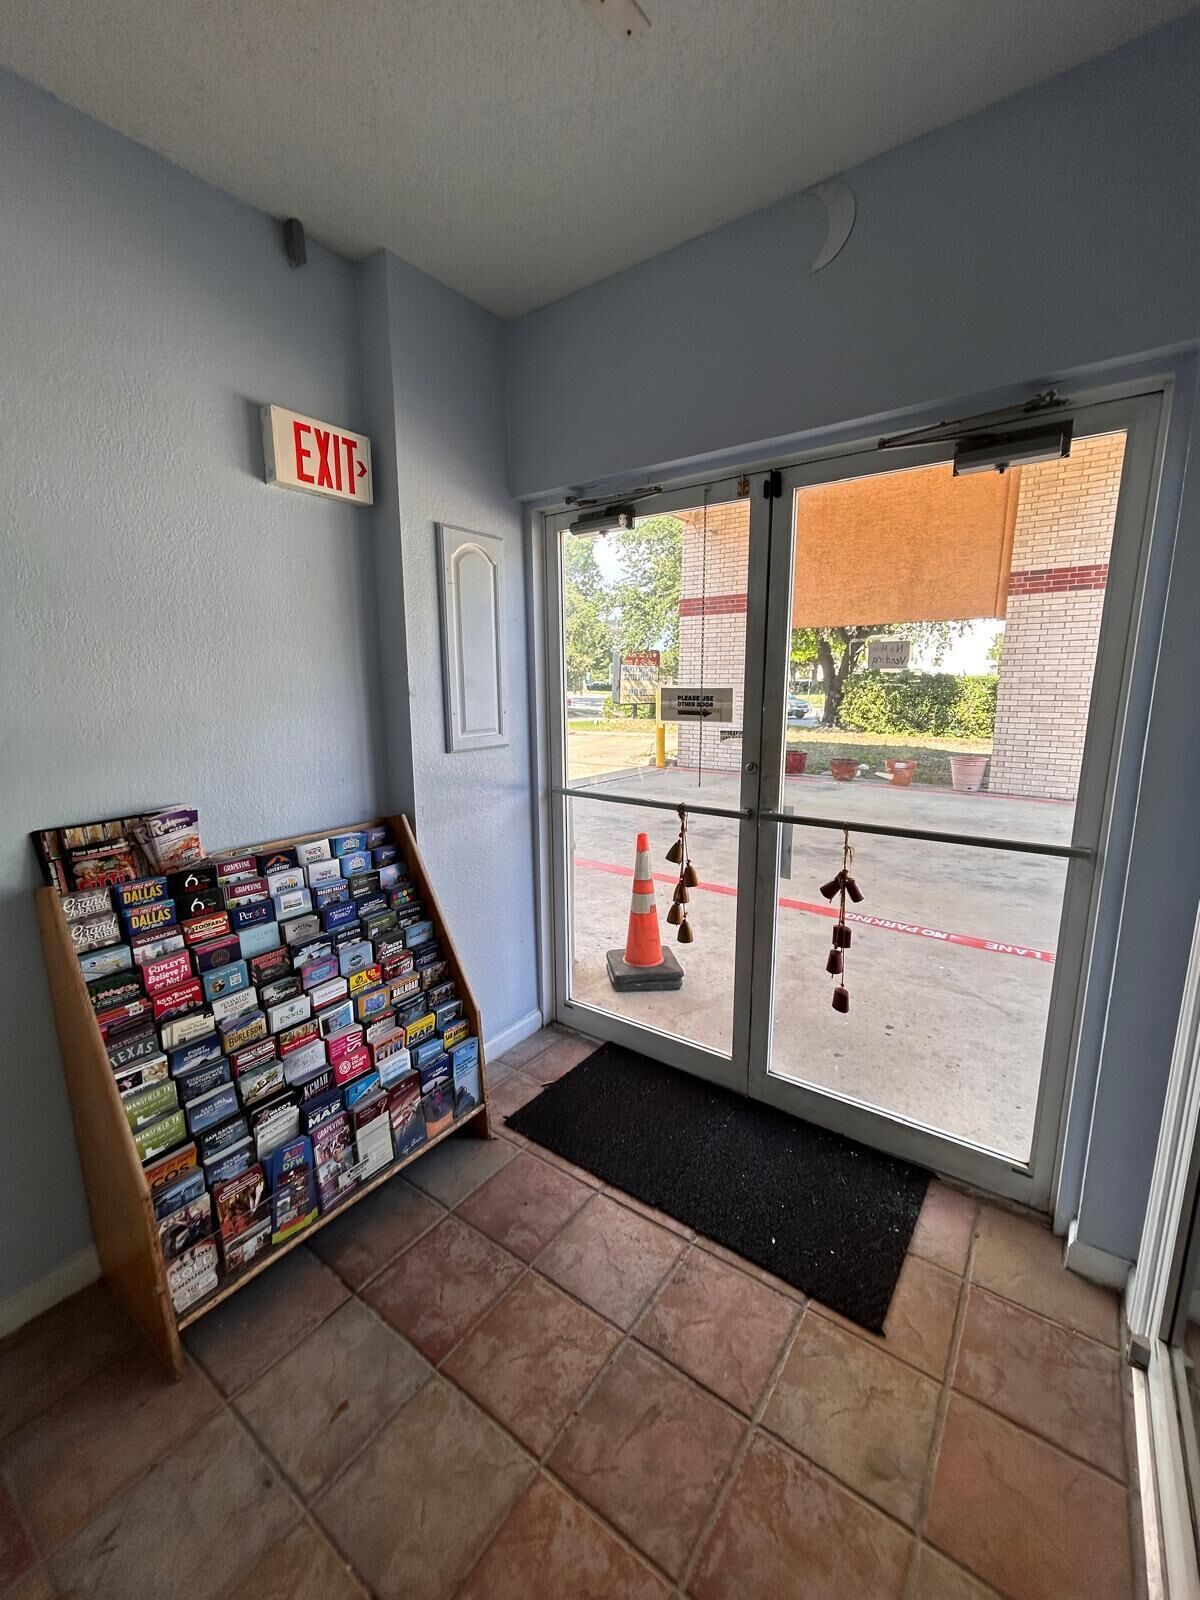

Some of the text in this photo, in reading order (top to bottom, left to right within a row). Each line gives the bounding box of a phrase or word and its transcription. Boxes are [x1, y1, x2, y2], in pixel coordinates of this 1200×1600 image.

[293, 421, 357, 494] EXIT
[224, 861, 249, 872] GRAPEVINE
[124, 885, 162, 904] DALLAS
[235, 883, 260, 894] GRAPEVINE
[65, 890, 108, 918] Grand
[74, 901, 110, 916] PRAIRIE
[132, 909, 170, 928] DALLAS
[846, 912, 918, 934] PARKING
[74, 917, 116, 945] Grand
[81, 928, 118, 943] PRAIRIE
[922, 929, 948, 940] NO
[984, 940, 1042, 959] LANE
[150, 957, 184, 975] RIPLEY'S
[148, 968, 178, 984] Believe
[154, 973, 183, 989] or Not!
[393, 980, 418, 997] RAILROAD
[280, 1009, 303, 1024] ENNIS
[230, 1025, 262, 1047] BURLESON
[409, 1025, 432, 1043] MAP
[112, 1041, 154, 1068] TEXAS
[184, 1048, 209, 1061] GRIFFIN
[187, 1045, 205, 1056] FORT
[352, 1054, 366, 1065] ESCAPE
[352, 1061, 363, 1069] GAME
[127, 1091, 160, 1110] MANSFIELD
[309, 1104, 340, 1128] MAP
[136, 1122, 168, 1142] MANSFIELD
[205, 1120, 242, 1143] SAM RAYBURN
[318, 1118, 344, 1140] GRAPEVINE
[283, 1155, 304, 1172] DFW
[170, 1246, 211, 1276] ARE YOU
[172, 1254, 212, 1287] BOLD
[174, 1263, 214, 1293] ENOUGH?
